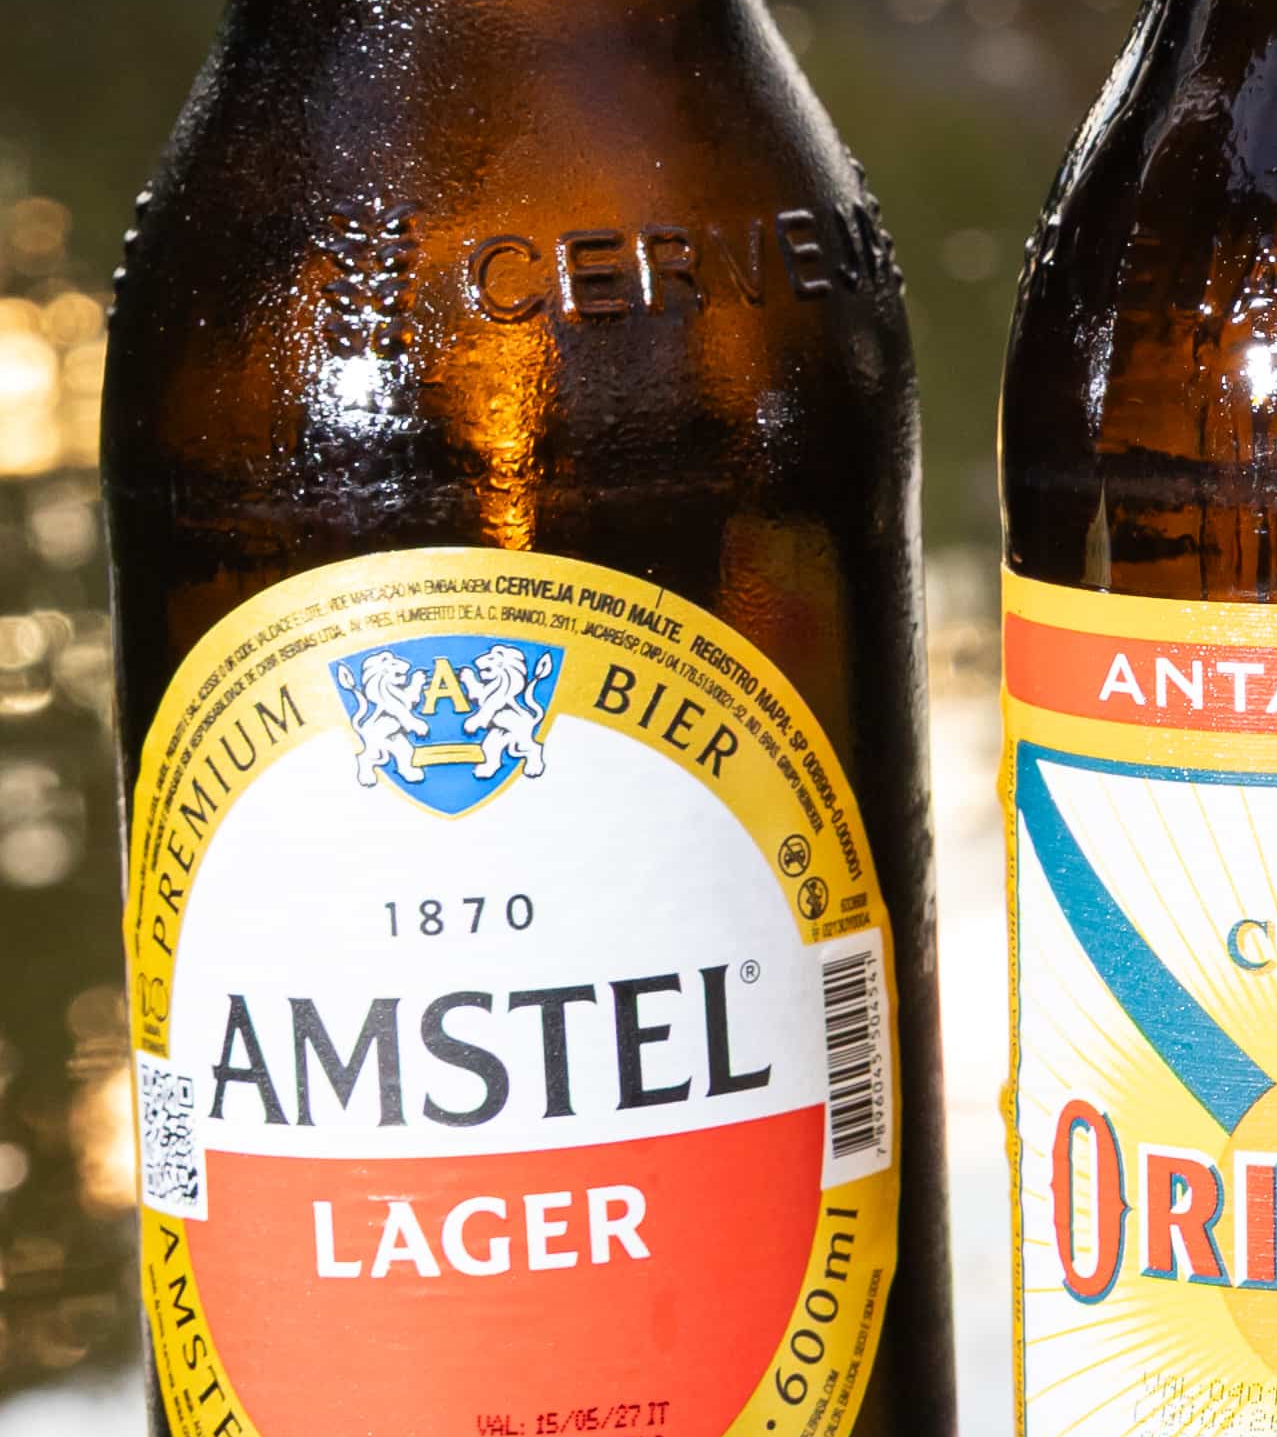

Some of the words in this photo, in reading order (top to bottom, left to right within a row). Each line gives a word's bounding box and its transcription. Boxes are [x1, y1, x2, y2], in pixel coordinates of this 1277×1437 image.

[457, 605, 473, 621] DE
[549, 612, 580, 636] 2911,
[495, 575, 574, 607] CERVEJA
[577, 587, 627, 618] PURO
[627, 603, 684, 645] MALTE.
[689, 634, 759, 696] REGISTRO
[754, 686, 793, 738] MAPA:
[788, 729, 810, 754] SP
[152, 684, 306, 957] PREMIUM
[592, 663, 741, 780] BIER
[385, 893, 536, 937] 1870
[209, 963, 773, 1128] AMSTEL
[312, 1184, 652, 1279] LAGER
[776, 1205, 861, 1408] 600ml
